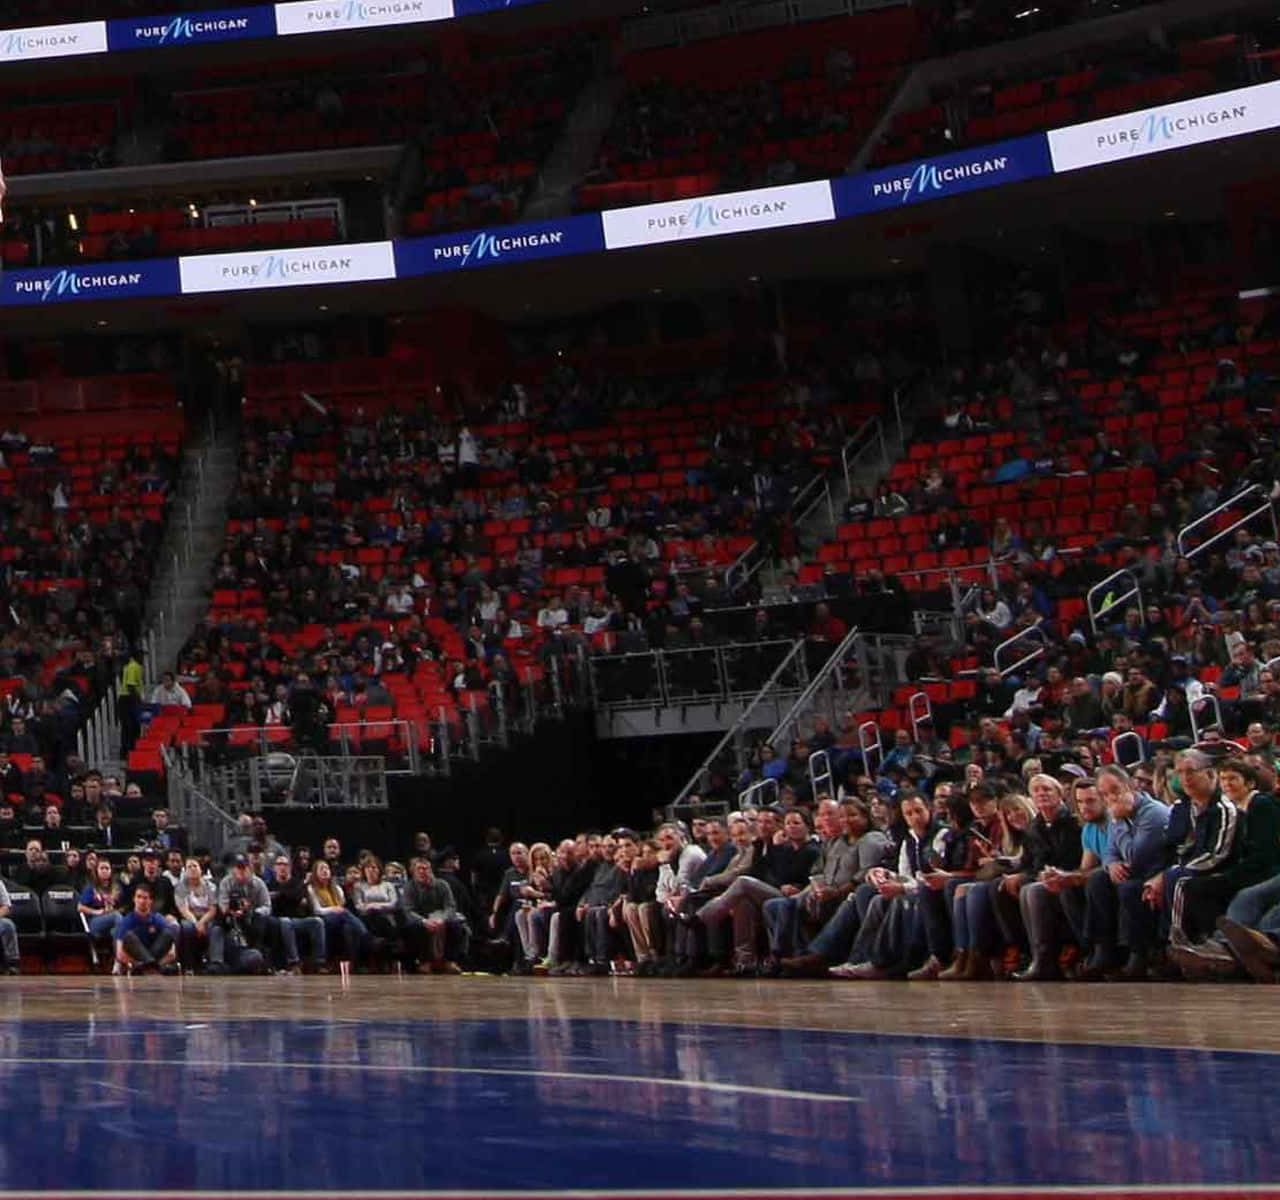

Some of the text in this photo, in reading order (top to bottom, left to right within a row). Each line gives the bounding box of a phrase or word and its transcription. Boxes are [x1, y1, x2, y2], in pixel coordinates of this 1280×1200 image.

[307, 0, 423, 27] PURE MICHIGAN
[135, 16, 248, 43] PURE MICHIGAN
[1096, 105, 1247, 156] PURE MICHIGAN
[873, 158, 1008, 202] PURE MICHIGAN
[647, 201, 786, 236] PURE MICHIGAN
[434, 232, 563, 265] PURE MICHIGAN
[15, 270, 141, 299] PURE MICHIGAN
[221, 254, 351, 284] PURE MICHIGAN
